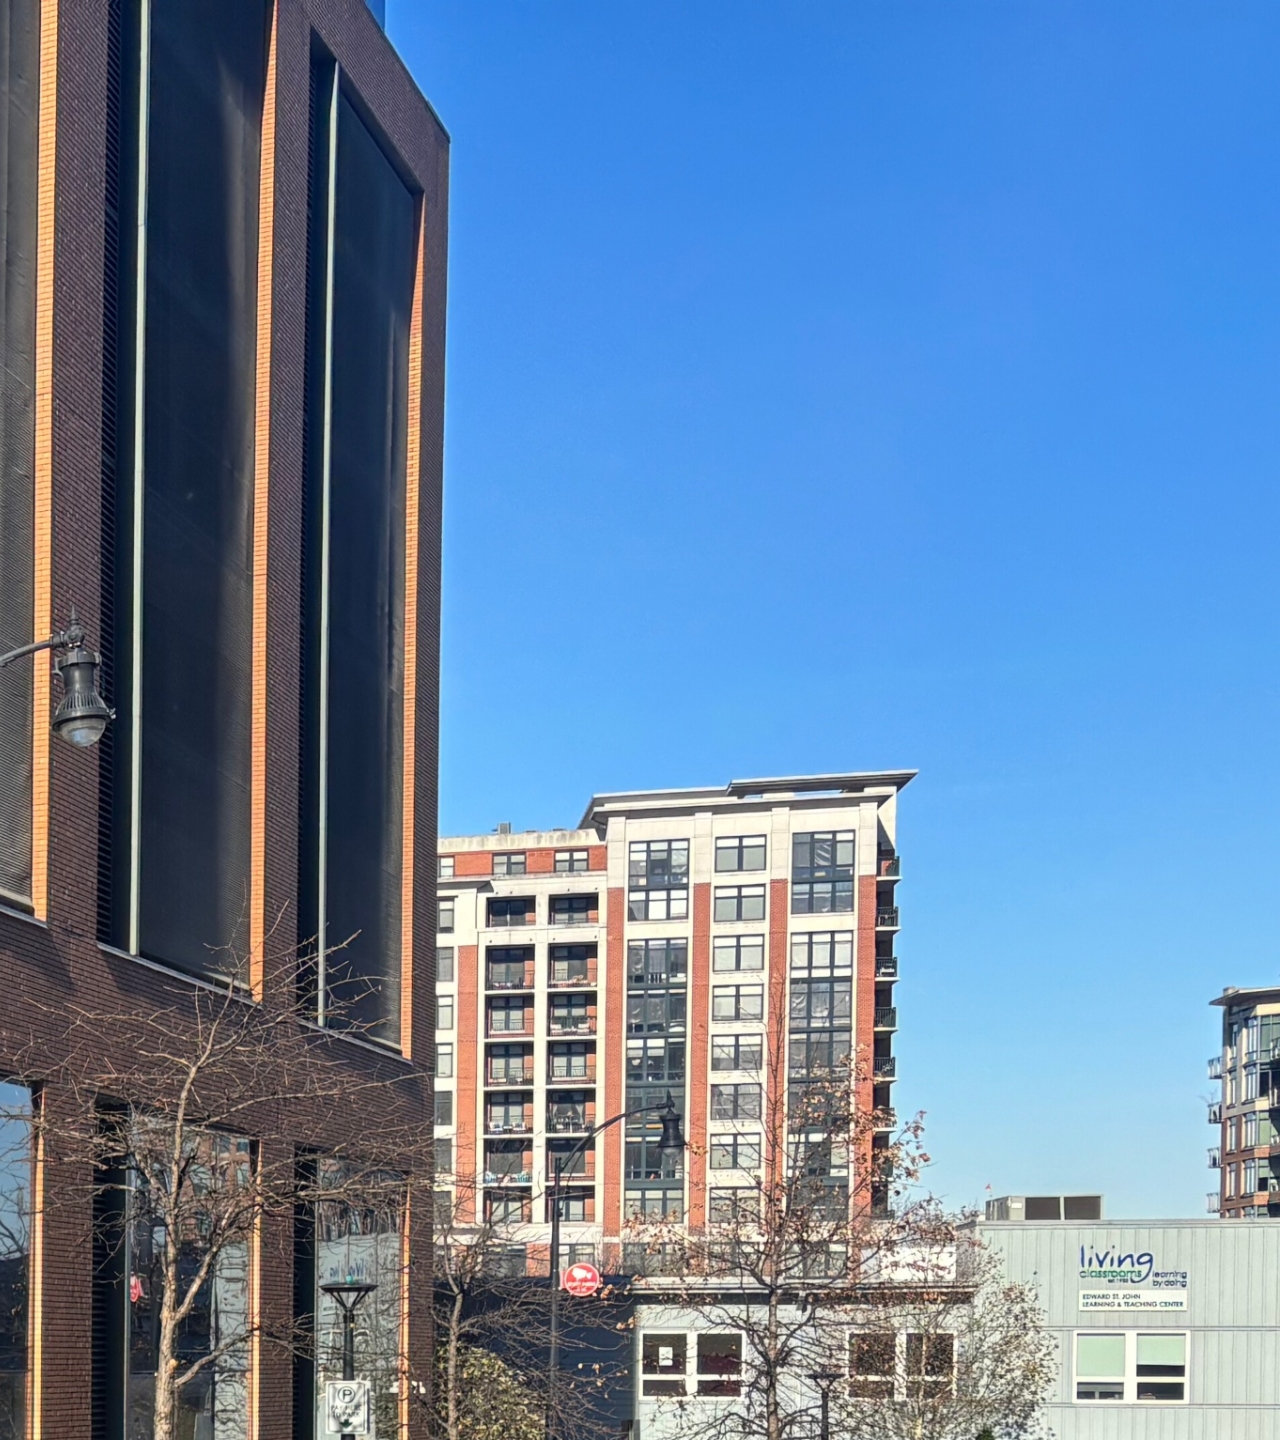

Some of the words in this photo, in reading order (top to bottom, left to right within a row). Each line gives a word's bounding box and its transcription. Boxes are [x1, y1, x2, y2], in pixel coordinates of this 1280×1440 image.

[1080, 1244, 1154, 1284] living
[1079, 1269, 1142, 1279] classrooms
[342, 1389, 352, 1401] P
